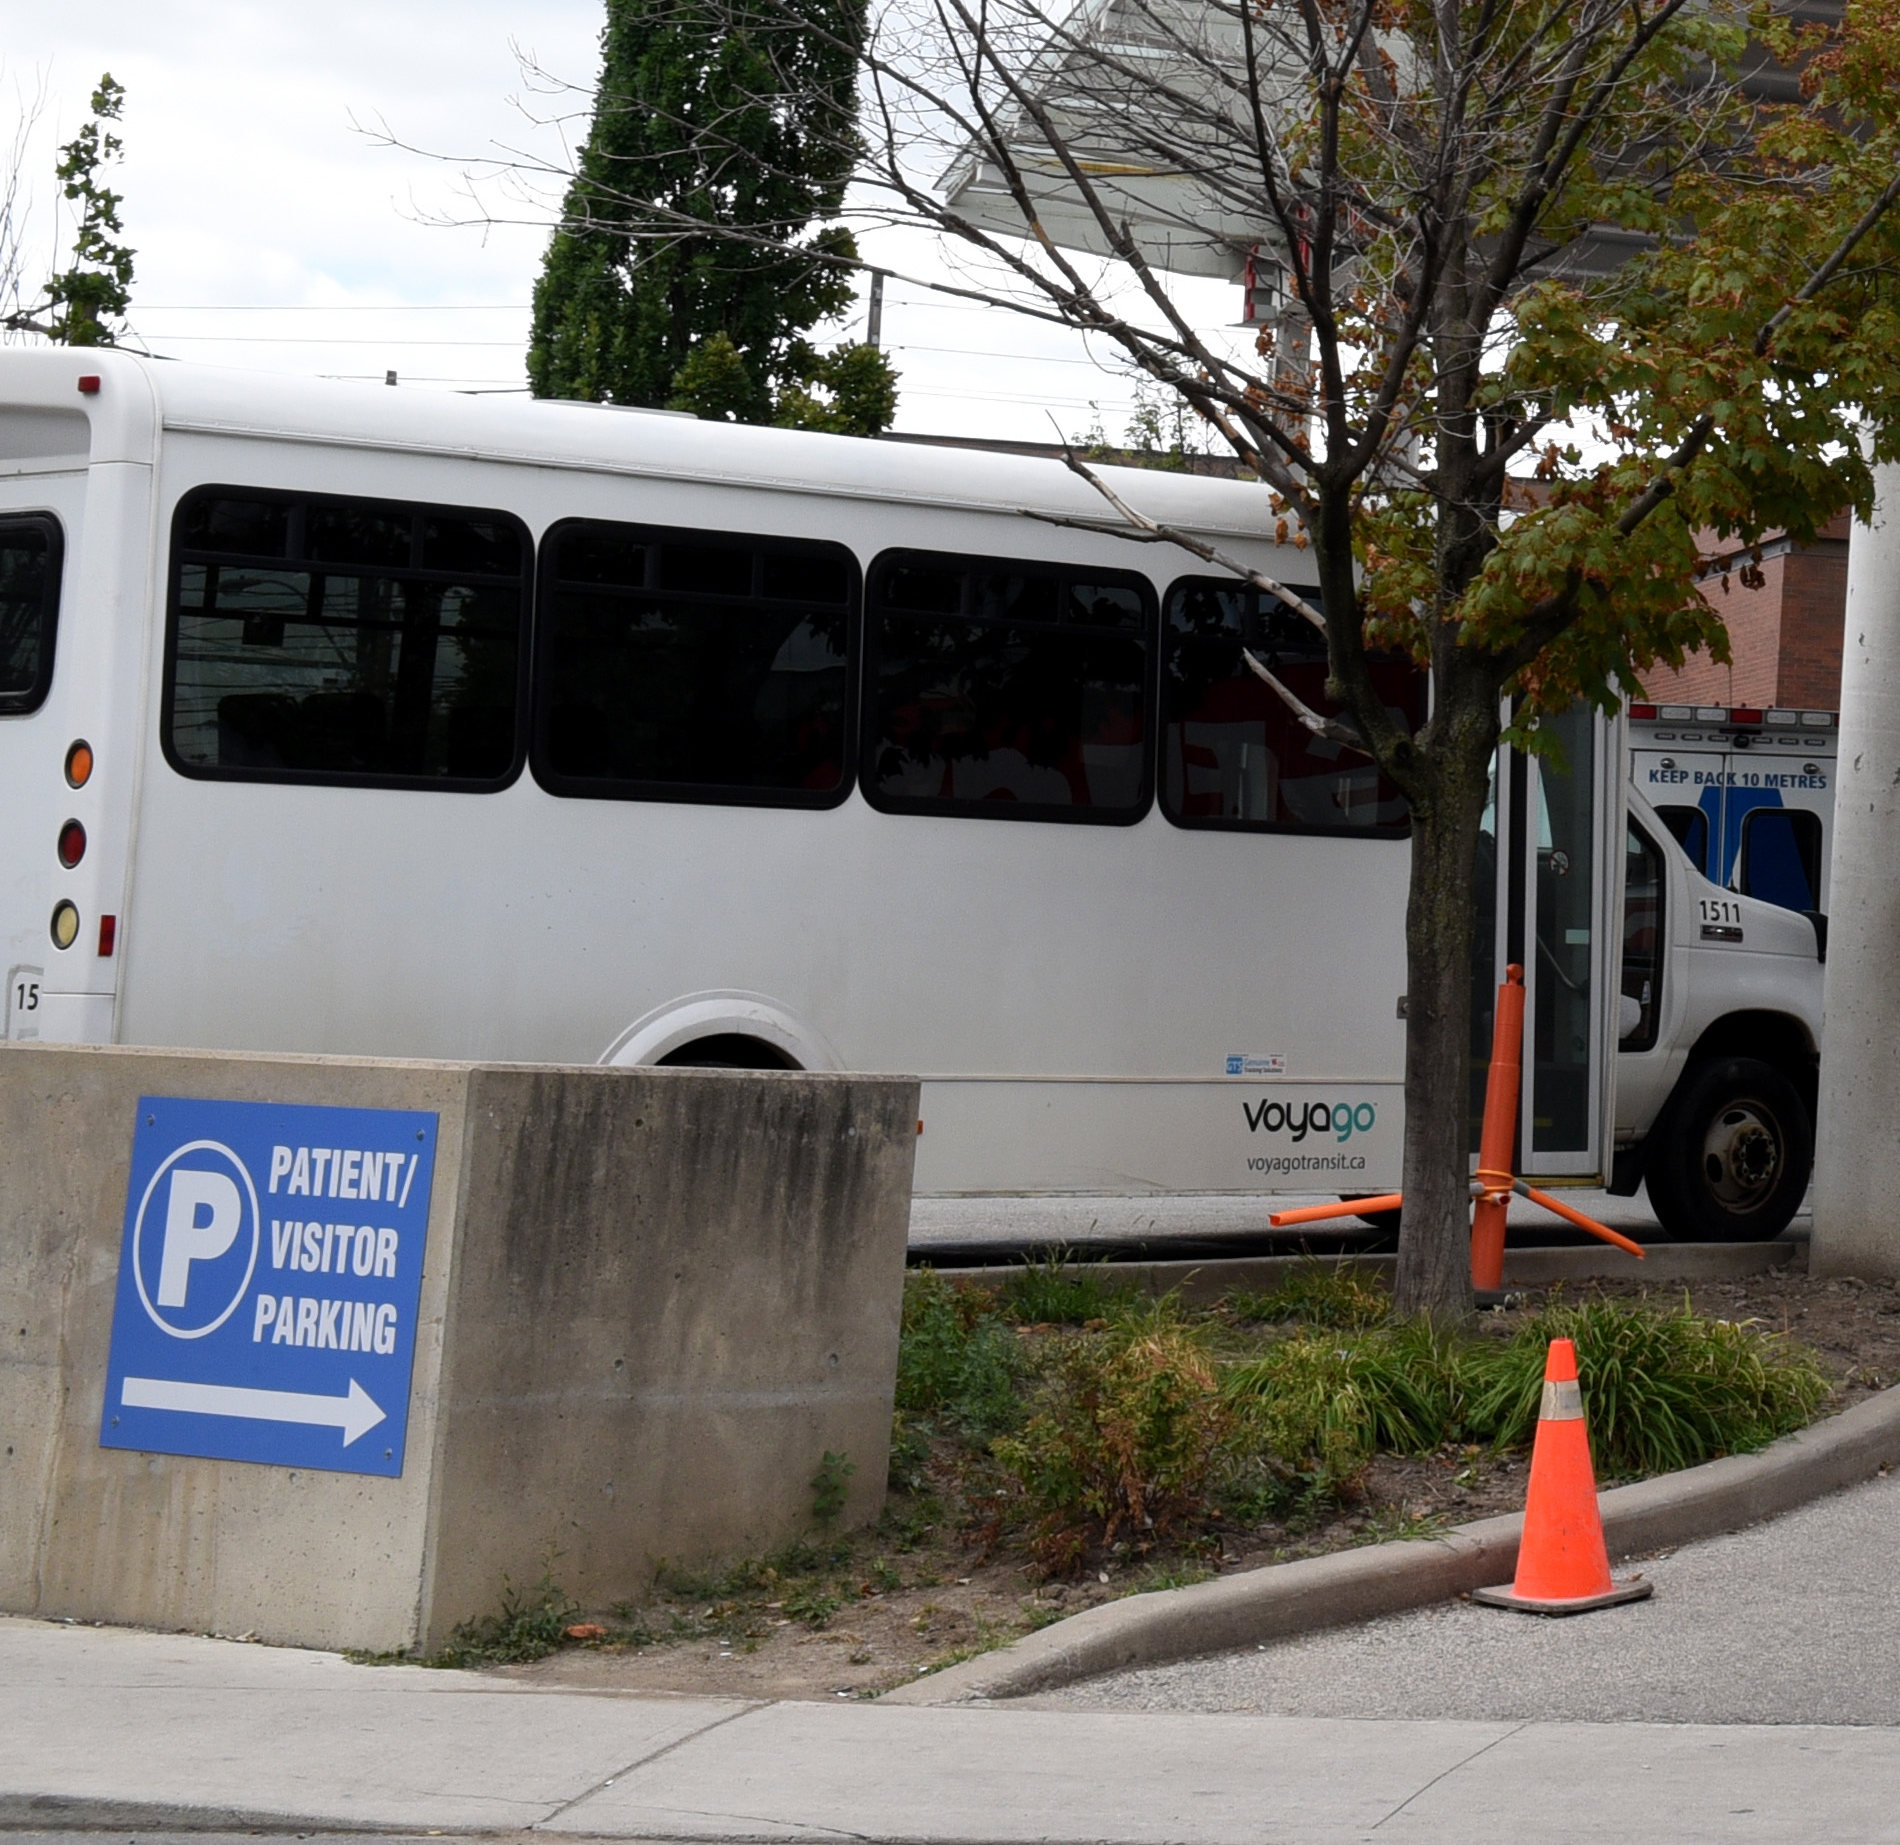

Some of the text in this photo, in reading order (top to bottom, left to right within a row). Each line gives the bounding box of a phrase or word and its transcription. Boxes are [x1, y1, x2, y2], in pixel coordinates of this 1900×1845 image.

[1649, 769, 1827, 789] KEEP BACK 10 METRES
[1700, 900, 1740, 923] 1511
[18, 983, 39, 1010] 15
[269, 1145, 418, 1209] PATIENT/
[1247, 1153, 1366, 1175] voyagotransit.ca
[157, 1169, 242, 1308] P
[271, 1220, 398, 1278] VISITOR
[253, 1294, 397, 1354] PARKING
